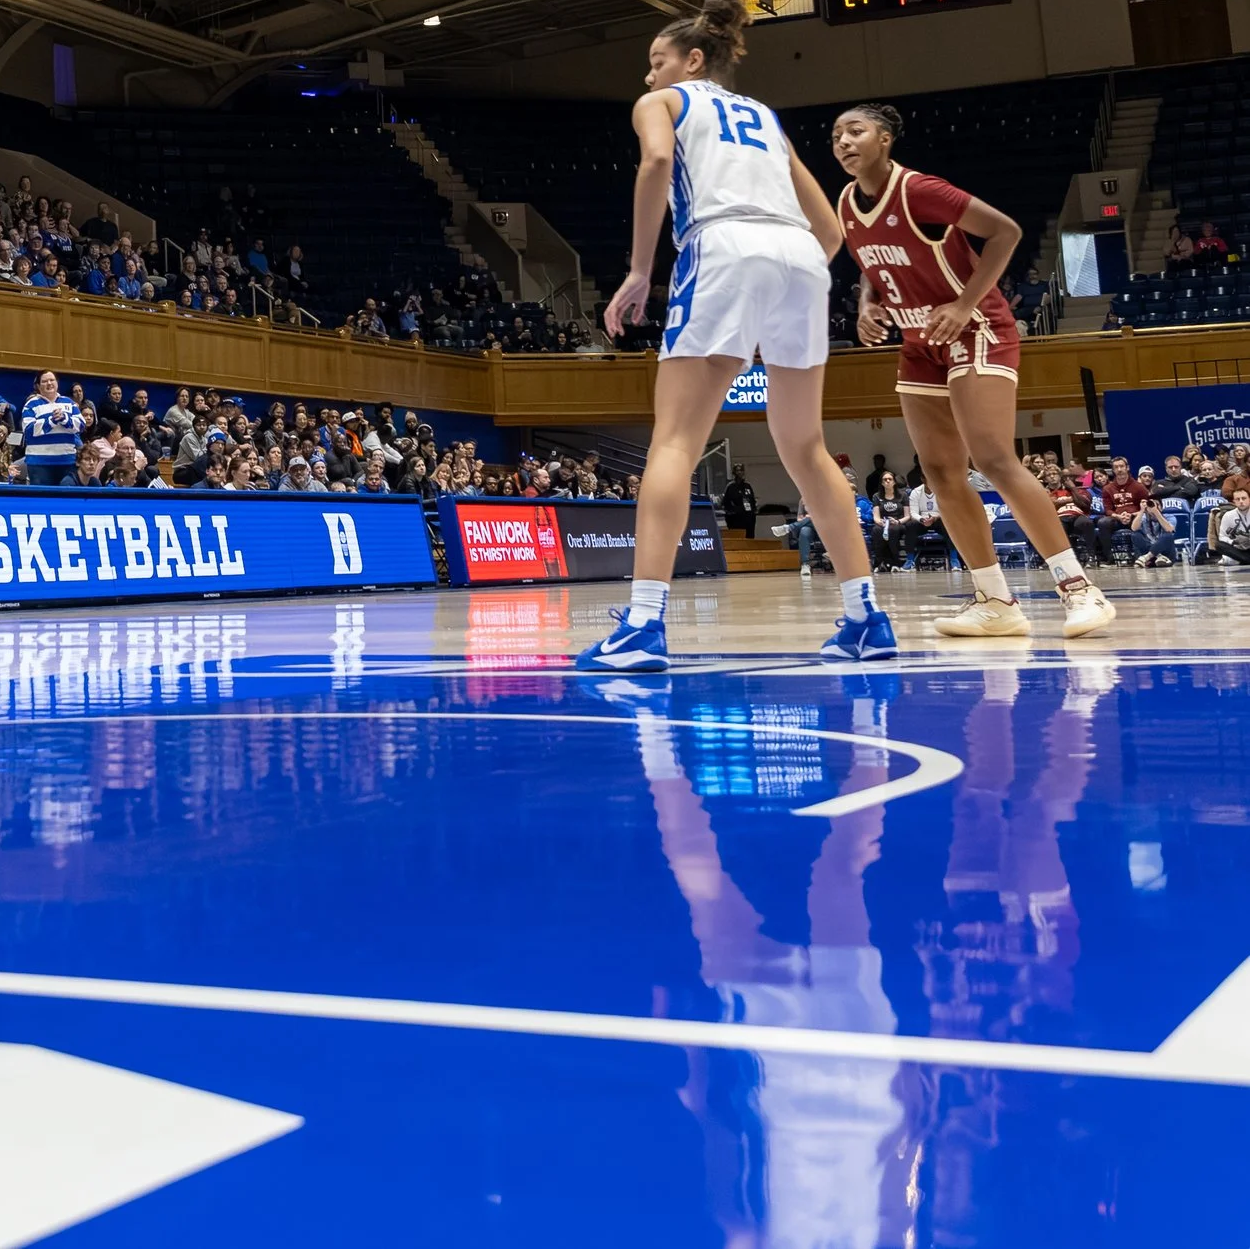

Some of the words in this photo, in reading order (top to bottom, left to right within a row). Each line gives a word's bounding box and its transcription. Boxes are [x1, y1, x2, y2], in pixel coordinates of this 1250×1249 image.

[712, 98, 768, 152] 12
[879, 269, 902, 304] 3
[464, 521, 491, 544] FAN
[491, 521, 533, 544] WORK
[567, 533, 583, 548] Over
[583, 534, 591, 548] 30
[592, 533, 607, 548] Hotel
[608, 534, 627, 548] Brands
[470, 548, 478, 562] IS
[478, 548, 511, 562] THIRSTY
[511, 547, 537, 561] WORK
